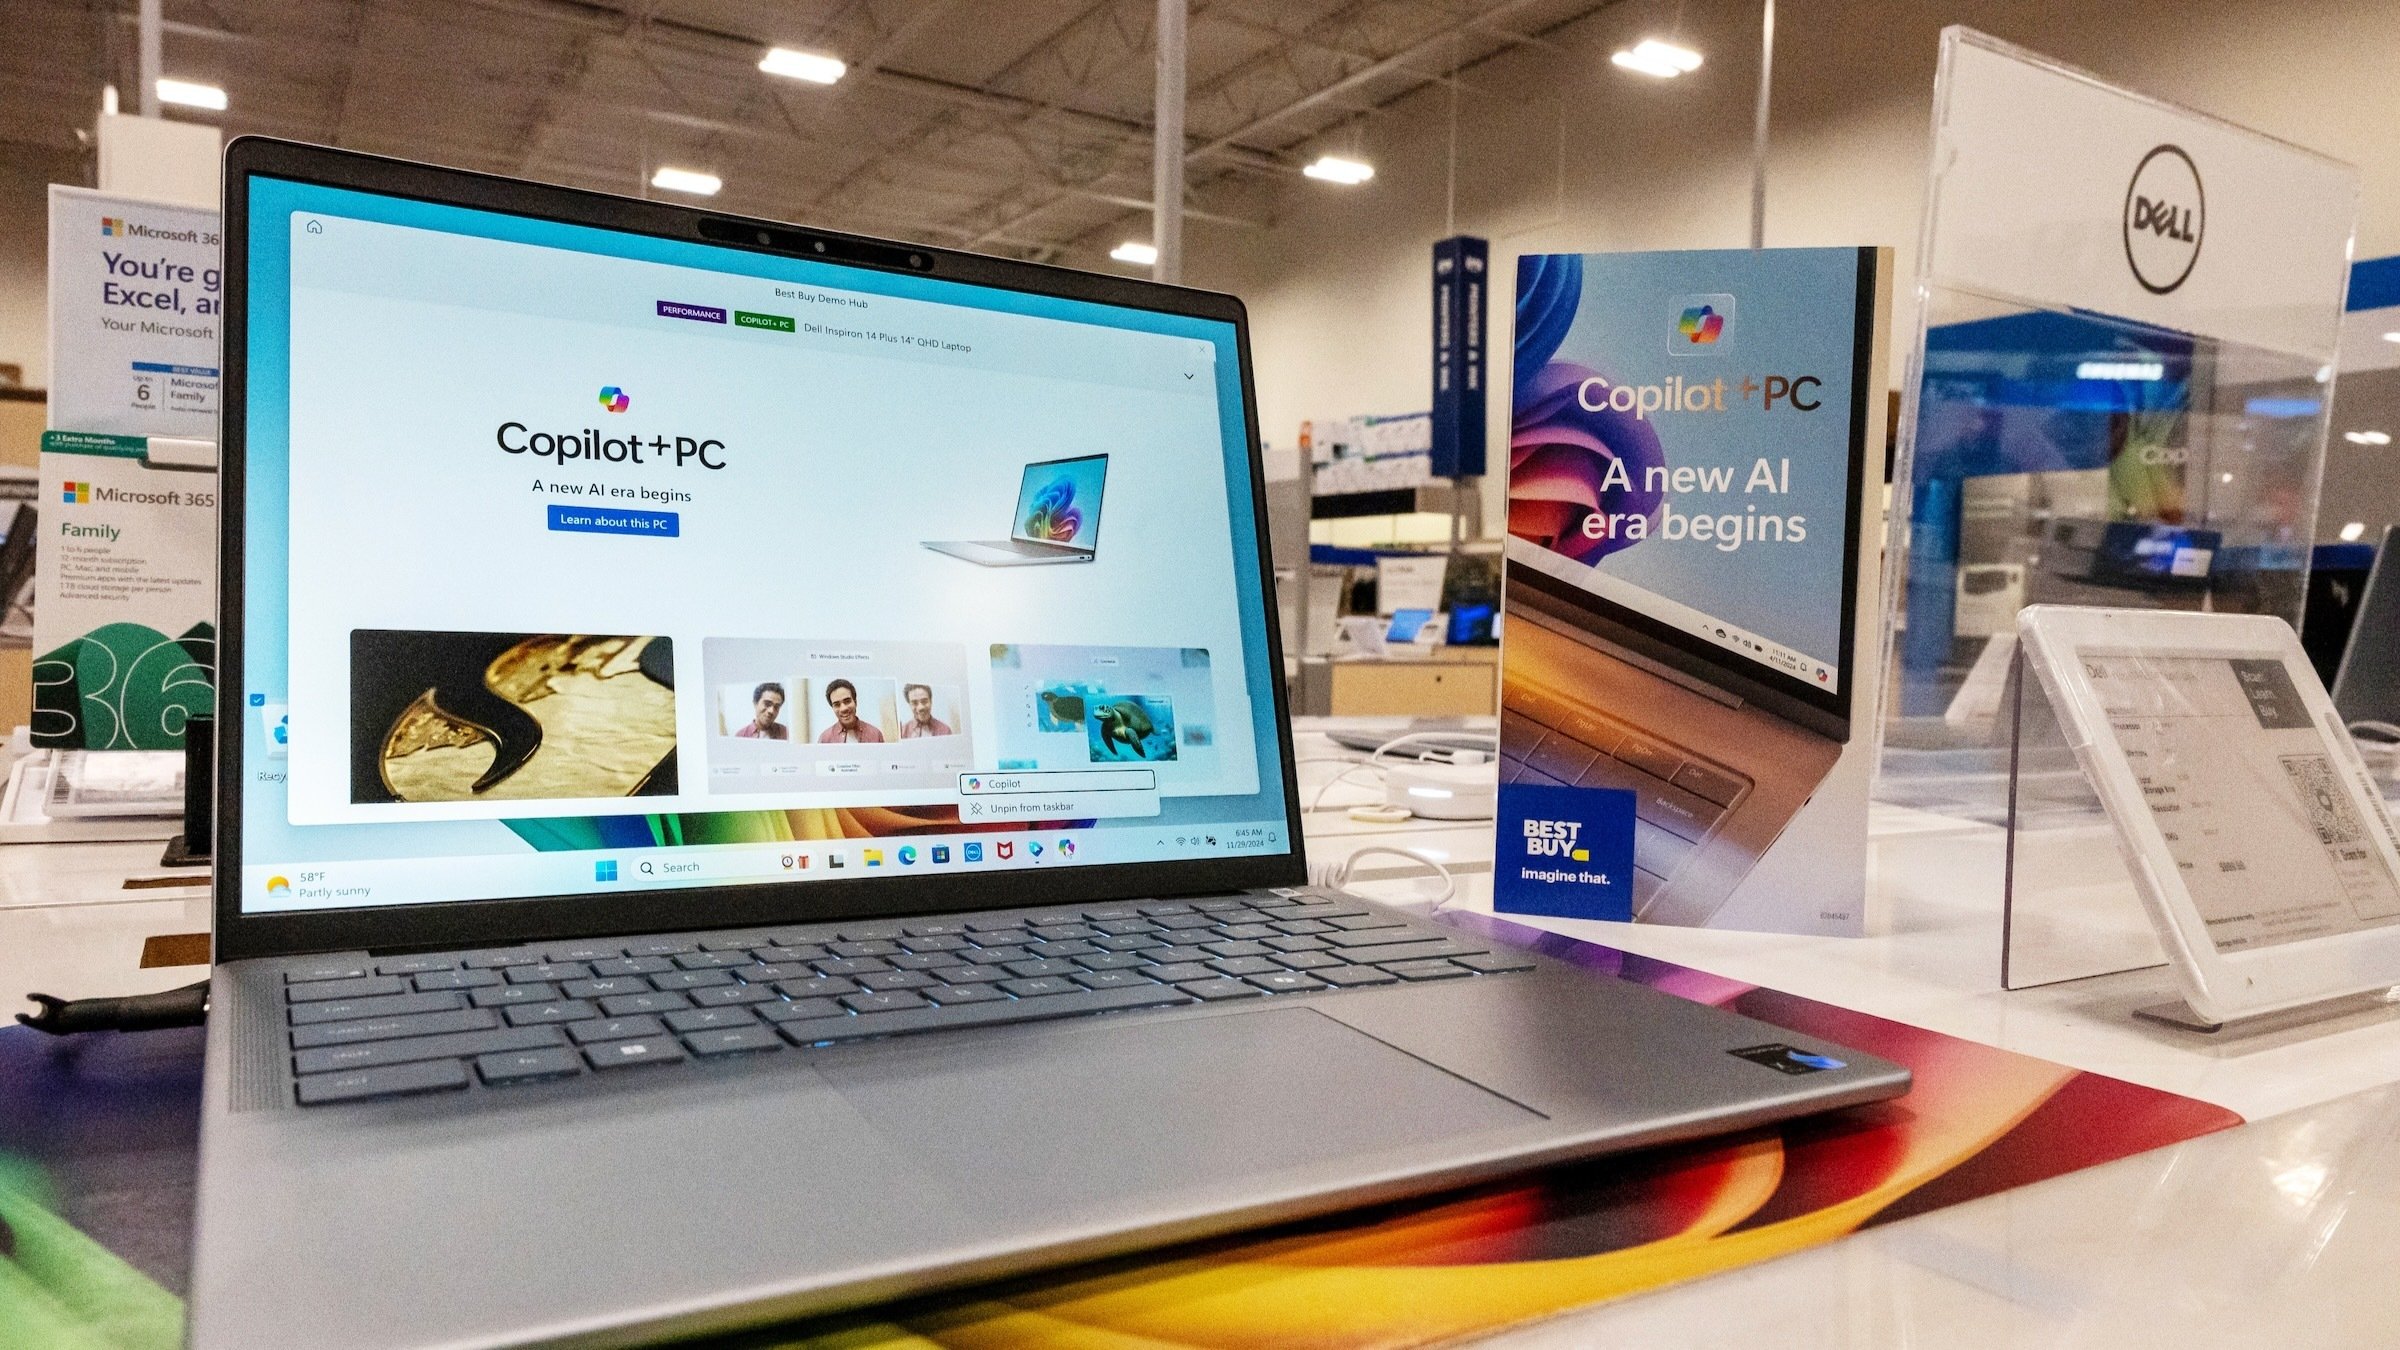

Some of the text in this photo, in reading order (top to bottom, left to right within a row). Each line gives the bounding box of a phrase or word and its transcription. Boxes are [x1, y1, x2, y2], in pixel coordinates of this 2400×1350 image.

[2133, 194, 2195, 244] DELL
[128, 223, 198, 244] Microsoft
[103, 281, 187, 316] Excel,
[775, 287, 869, 310] Best Buy Demo Hub
[662, 305, 721, 321] PERFORMANCE
[101, 316, 214, 340] Your Microsoft
[779, 320, 790, 330] PC
[804, 322, 823, 335] Dell
[825, 324, 863, 342] Inspiron
[866, 330, 877, 341] 14
[879, 331, 899, 344] Plus
[917, 337, 940, 350] QHD
[941, 340, 973, 354] Laptop
[137, 384, 151, 401] 6
[170, 390, 206, 404] Family
[1577, 375, 1728, 420] Copilot
[84, 436, 116, 445] Months
[1600, 457, 1790, 494] A new AI
[96, 487, 215, 508] Microsoft 365
[532, 479, 692, 504] A new AI era begins
[560, 513, 668, 531] Learn about this PC
[1581, 503, 1807, 552] era begins
[61, 522, 121, 543] Family
[988, 779, 1021, 791] Copilot
[991, 801, 1075, 815] Unpin from taskbar
[1655, 797, 1694, 819] Backspace
[1235, 828, 1263, 838] 6:45 AM
[1522, 818, 1582, 841] BEST
[1225, 838, 1265, 850] 11/29/2024
[1526, 838, 1577, 858] BUY
[300, 871, 326, 883] 58°F
[663, 860, 700, 874] Search
[1521, 866, 1611, 886] imagine that.
[299, 886, 371, 900] Partly sunny
